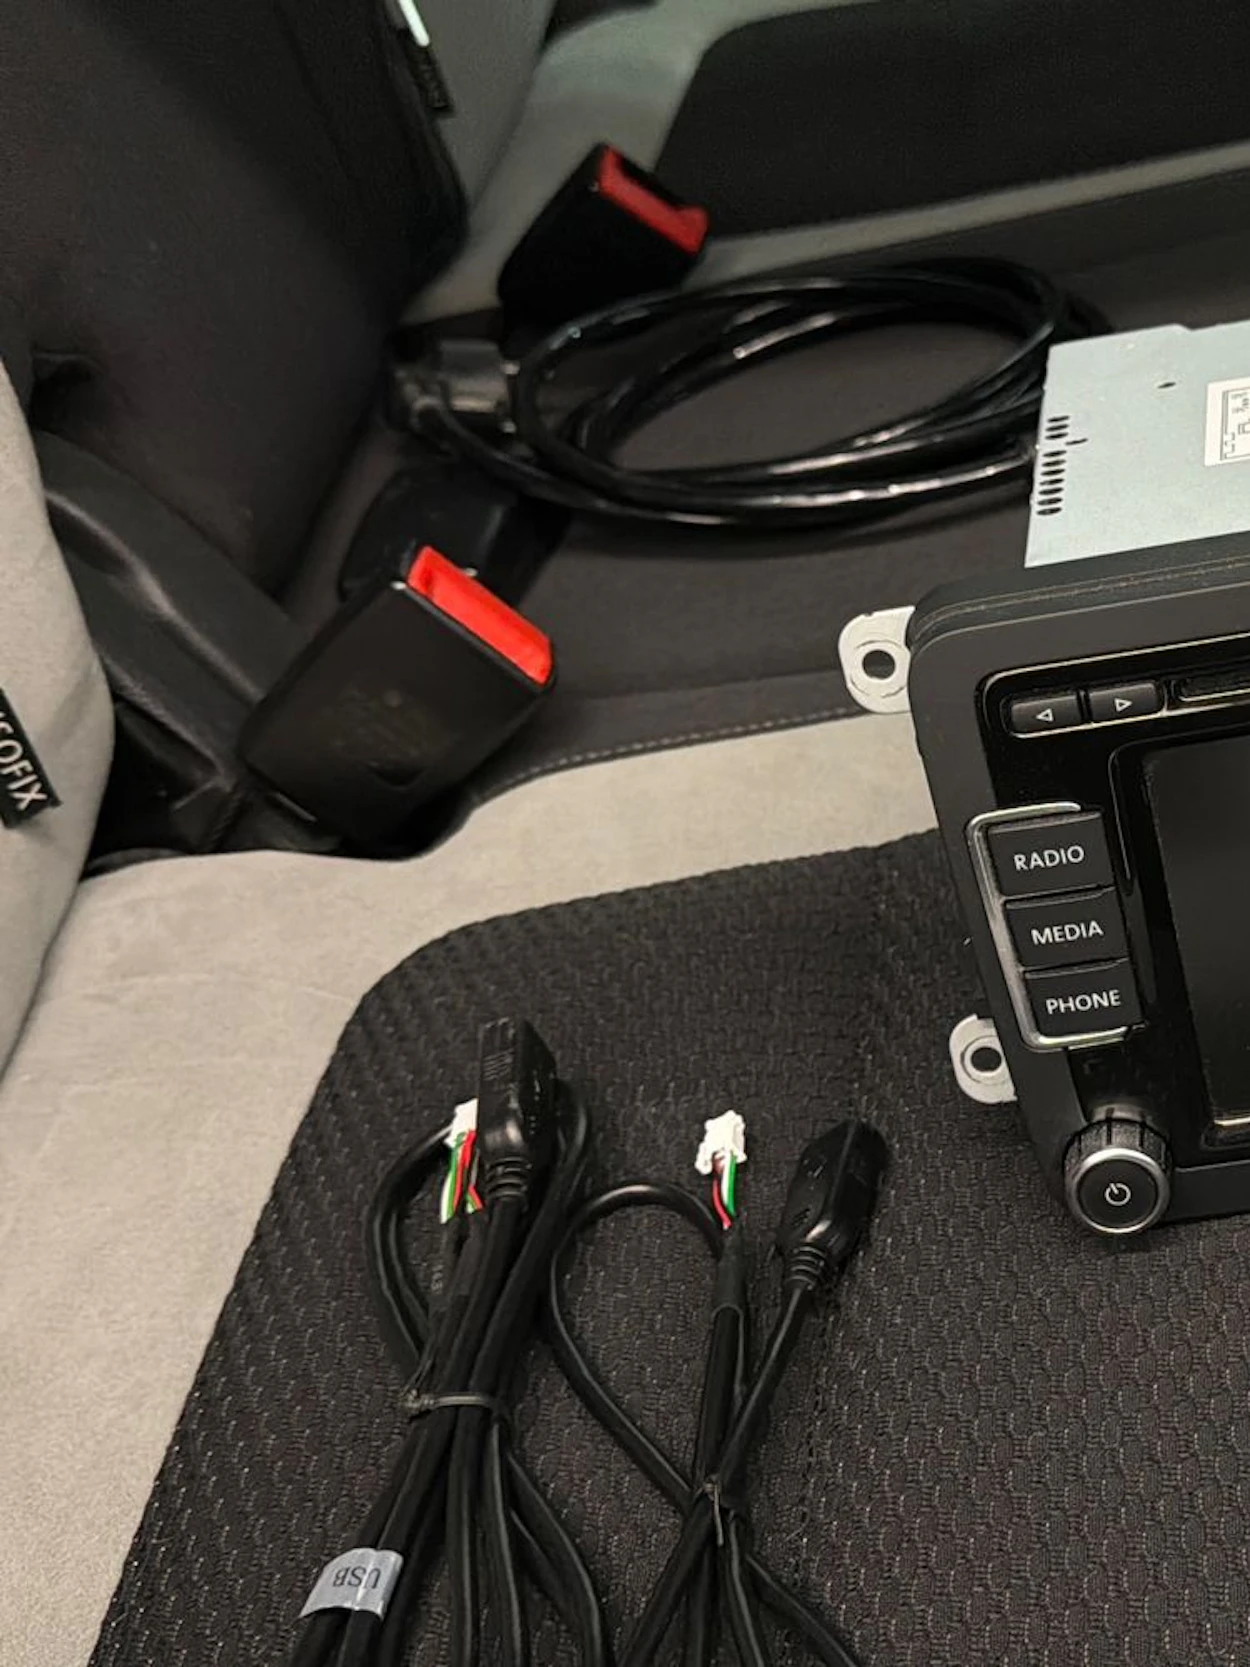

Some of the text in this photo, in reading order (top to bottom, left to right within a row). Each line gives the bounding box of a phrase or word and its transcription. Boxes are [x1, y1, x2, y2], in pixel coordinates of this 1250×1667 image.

[1013, 844, 1085, 871] RADIO
[1030, 920, 1104, 946] MEDIA
[1045, 989, 1121, 1015] PHONE
[332, 1564, 382, 1589] USB
